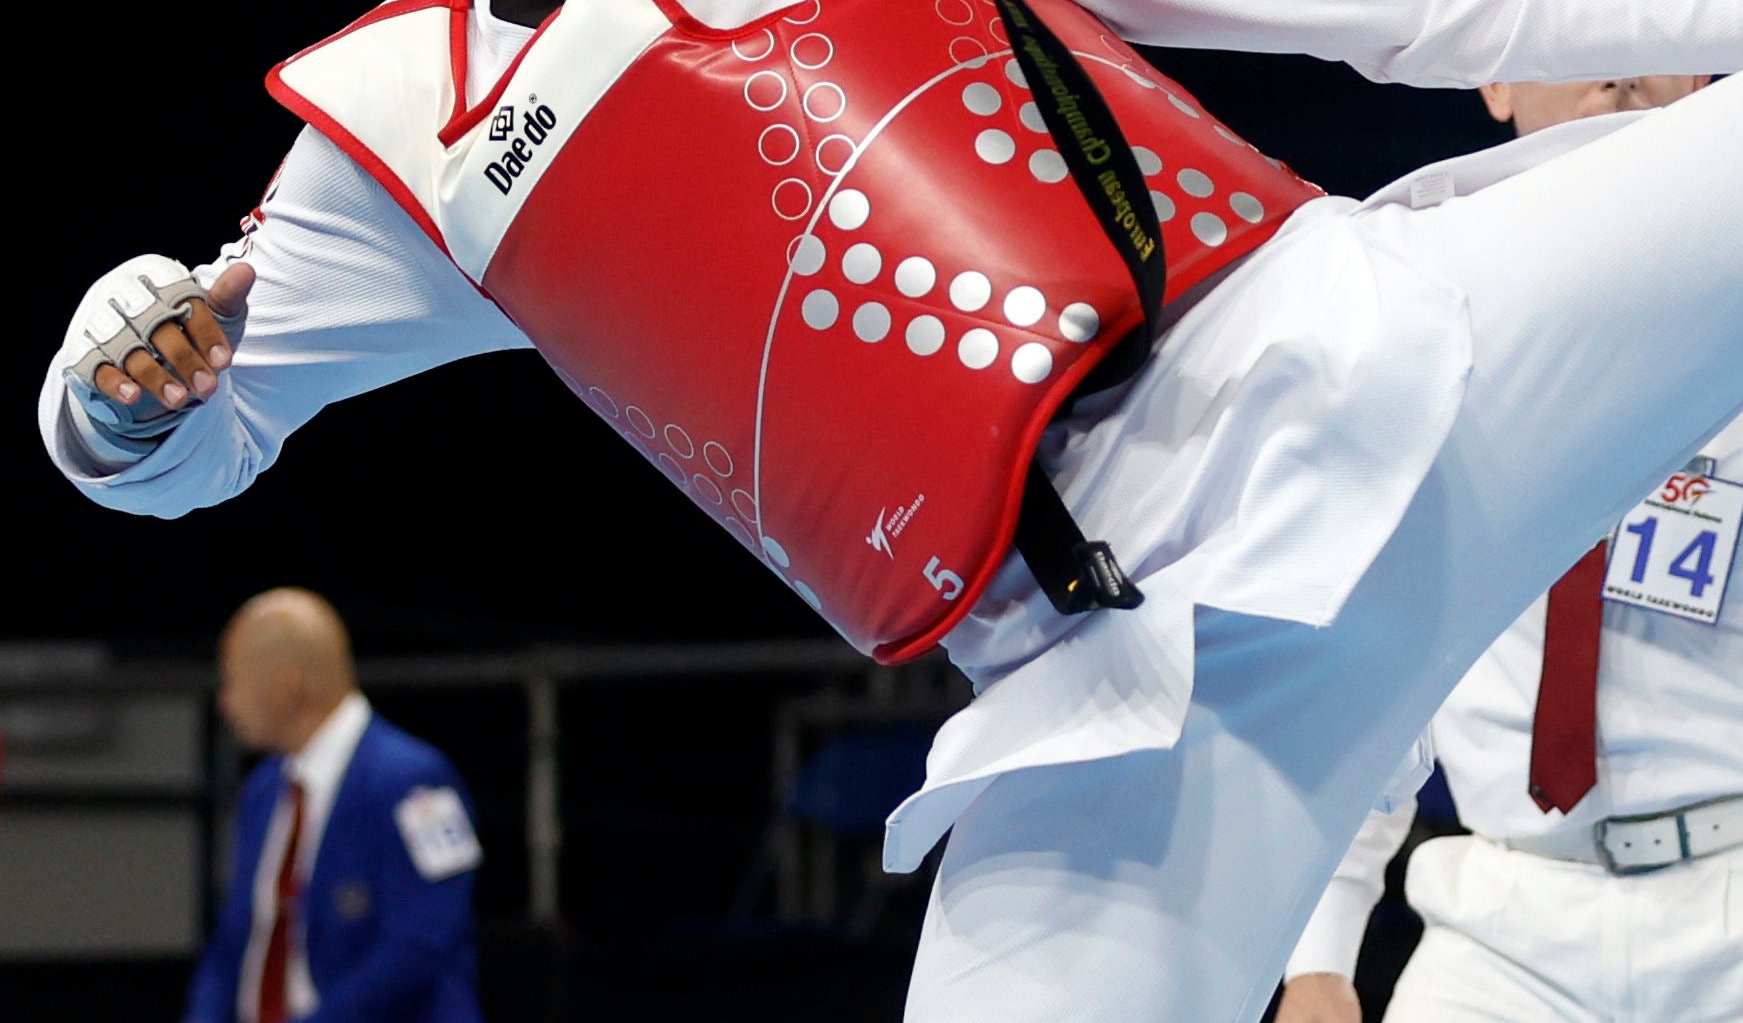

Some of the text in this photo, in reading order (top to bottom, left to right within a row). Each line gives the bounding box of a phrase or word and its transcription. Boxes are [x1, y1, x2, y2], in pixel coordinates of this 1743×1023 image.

[886, 505, 906, 532] WORLD
[892, 494, 926, 539] TAEKWONDO
[922, 555, 965, 601] 5
[1626, 516, 1719, 599] 14
